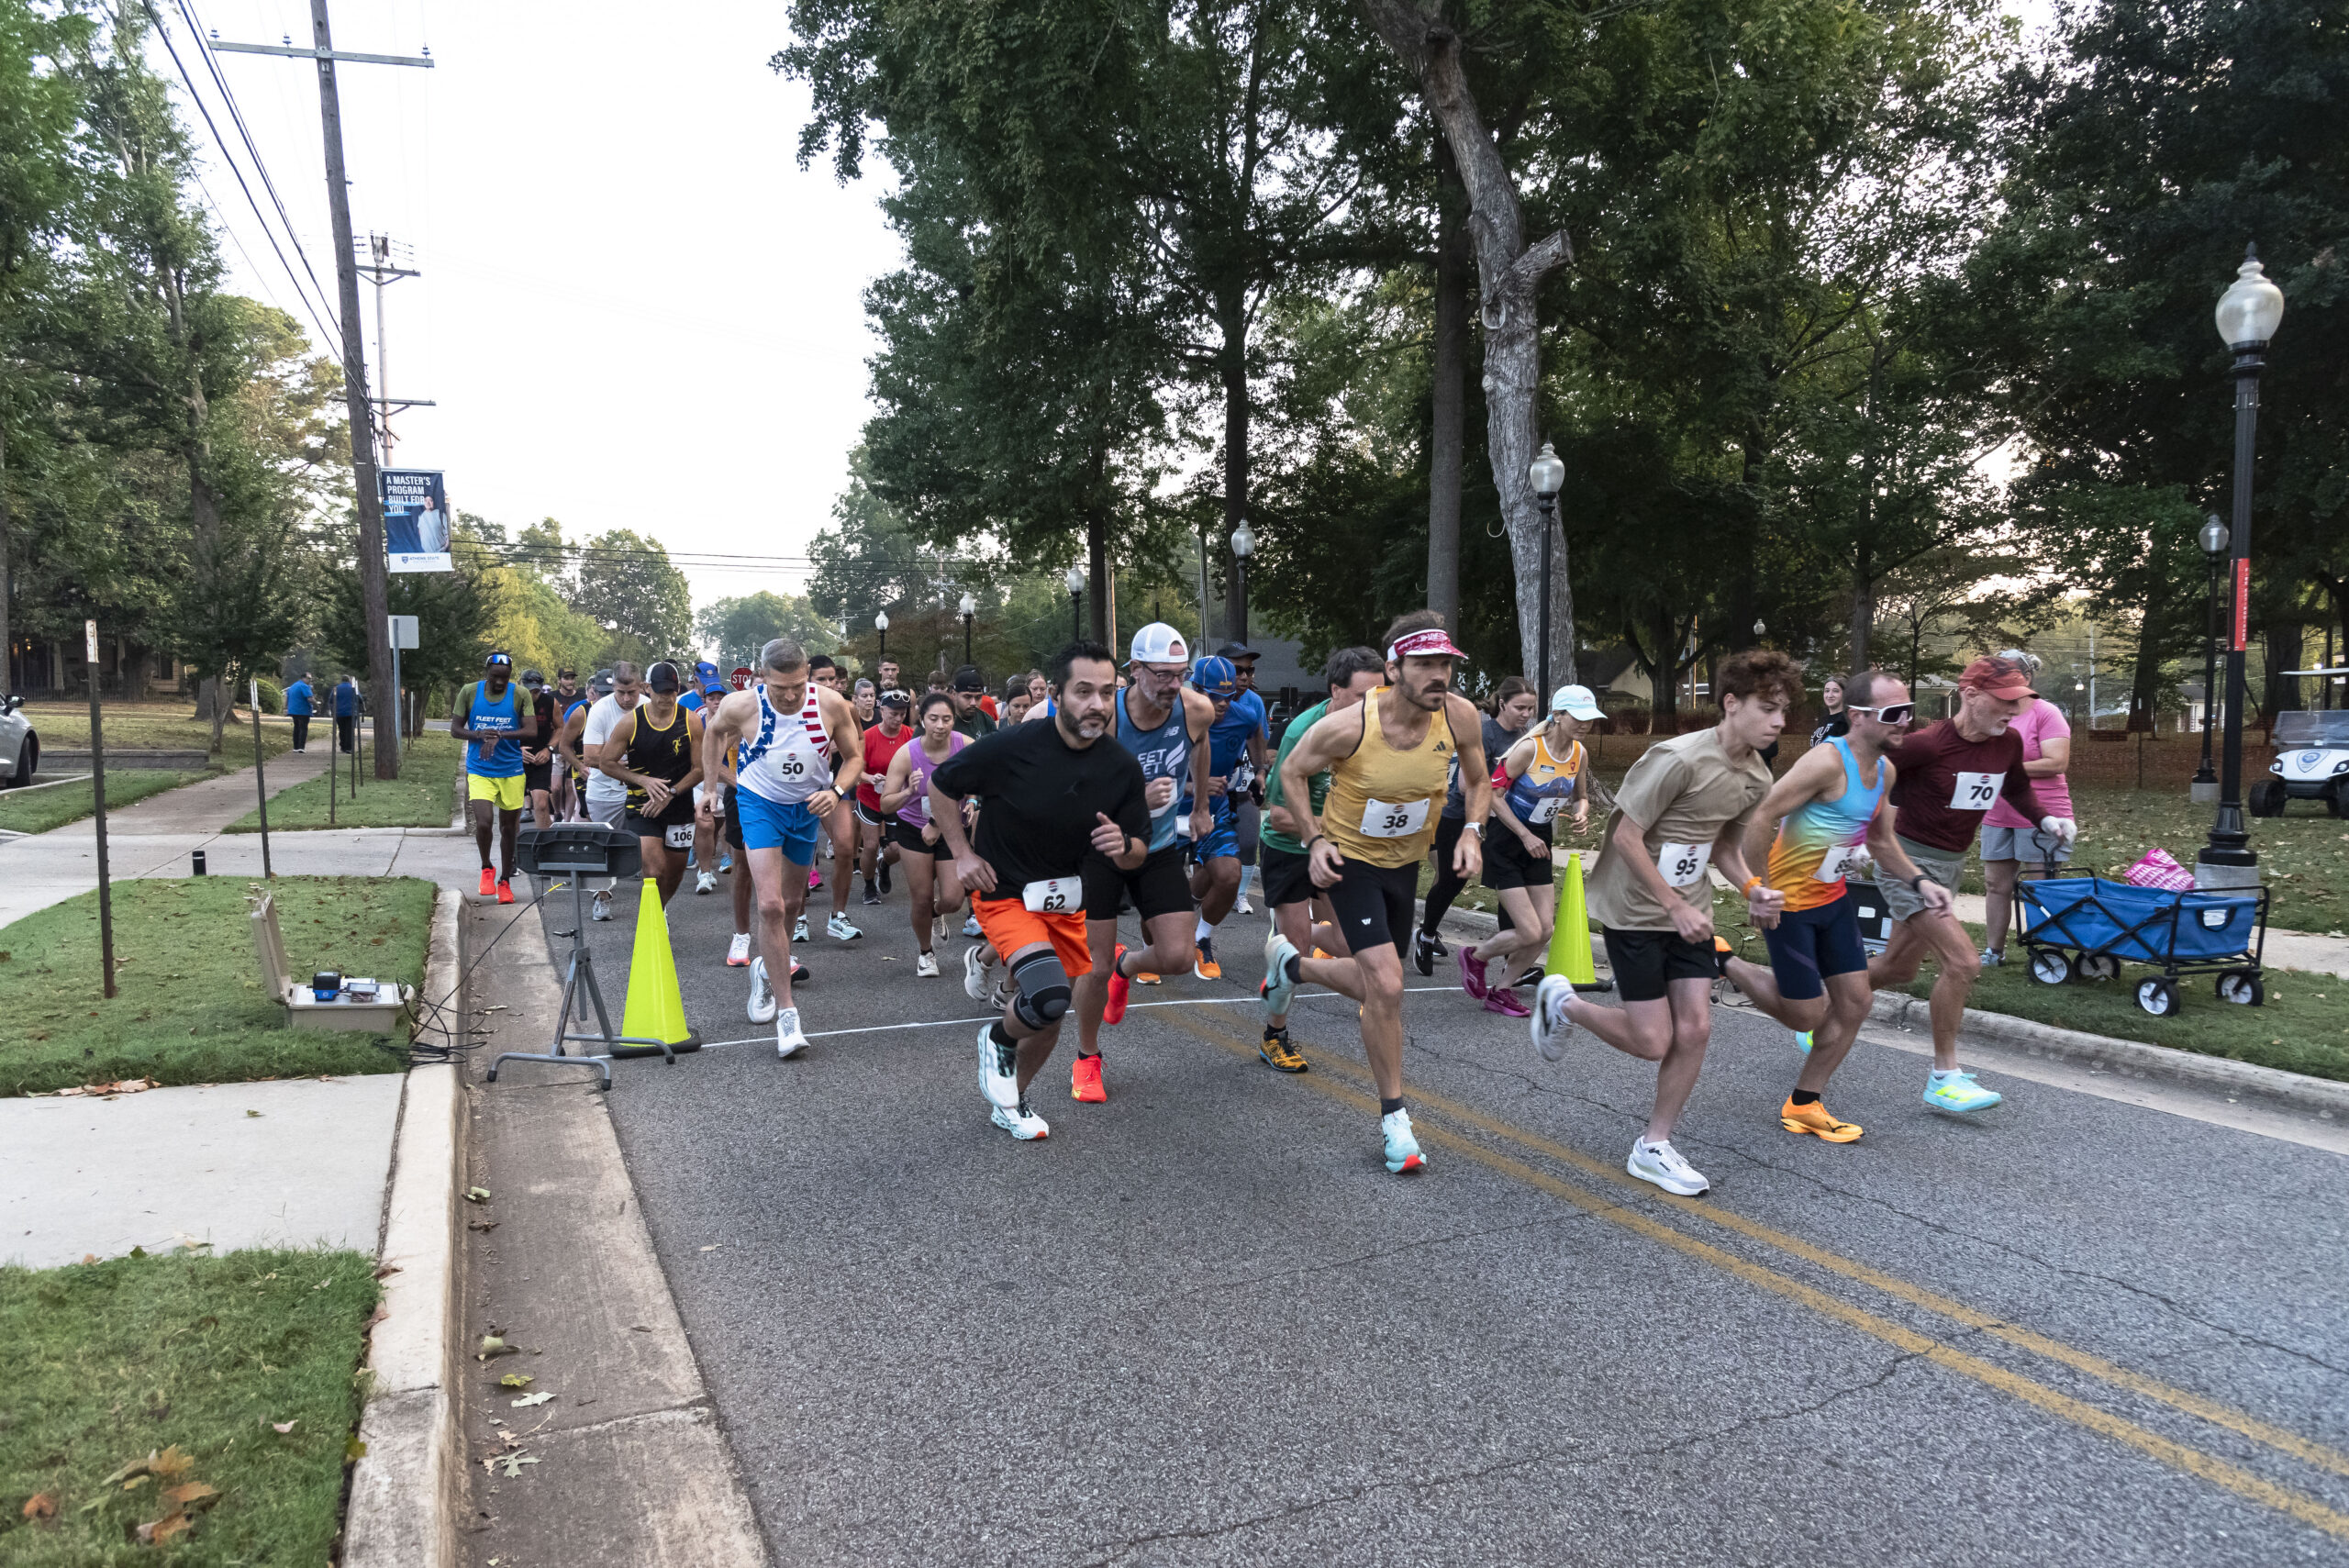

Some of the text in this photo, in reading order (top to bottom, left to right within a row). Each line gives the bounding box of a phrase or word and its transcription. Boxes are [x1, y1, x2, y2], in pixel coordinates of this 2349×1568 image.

[386, 475, 431, 485] A MASTER'S
[387, 485, 425, 495] PROGRAM
[388, 495, 425, 505] BUILT FOR
[388, 506, 405, 514] YOU
[1138, 748, 1167, 764] EET
[782, 762, 804, 775] 50
[1969, 784, 1994, 801] 70
[1544, 806, 1559, 817] 83
[1382, 814, 1408, 829] 38
[674, 830, 693, 842] 106
[1675, 858, 1698, 876] 95
[1042, 894, 1066, 912] 62
